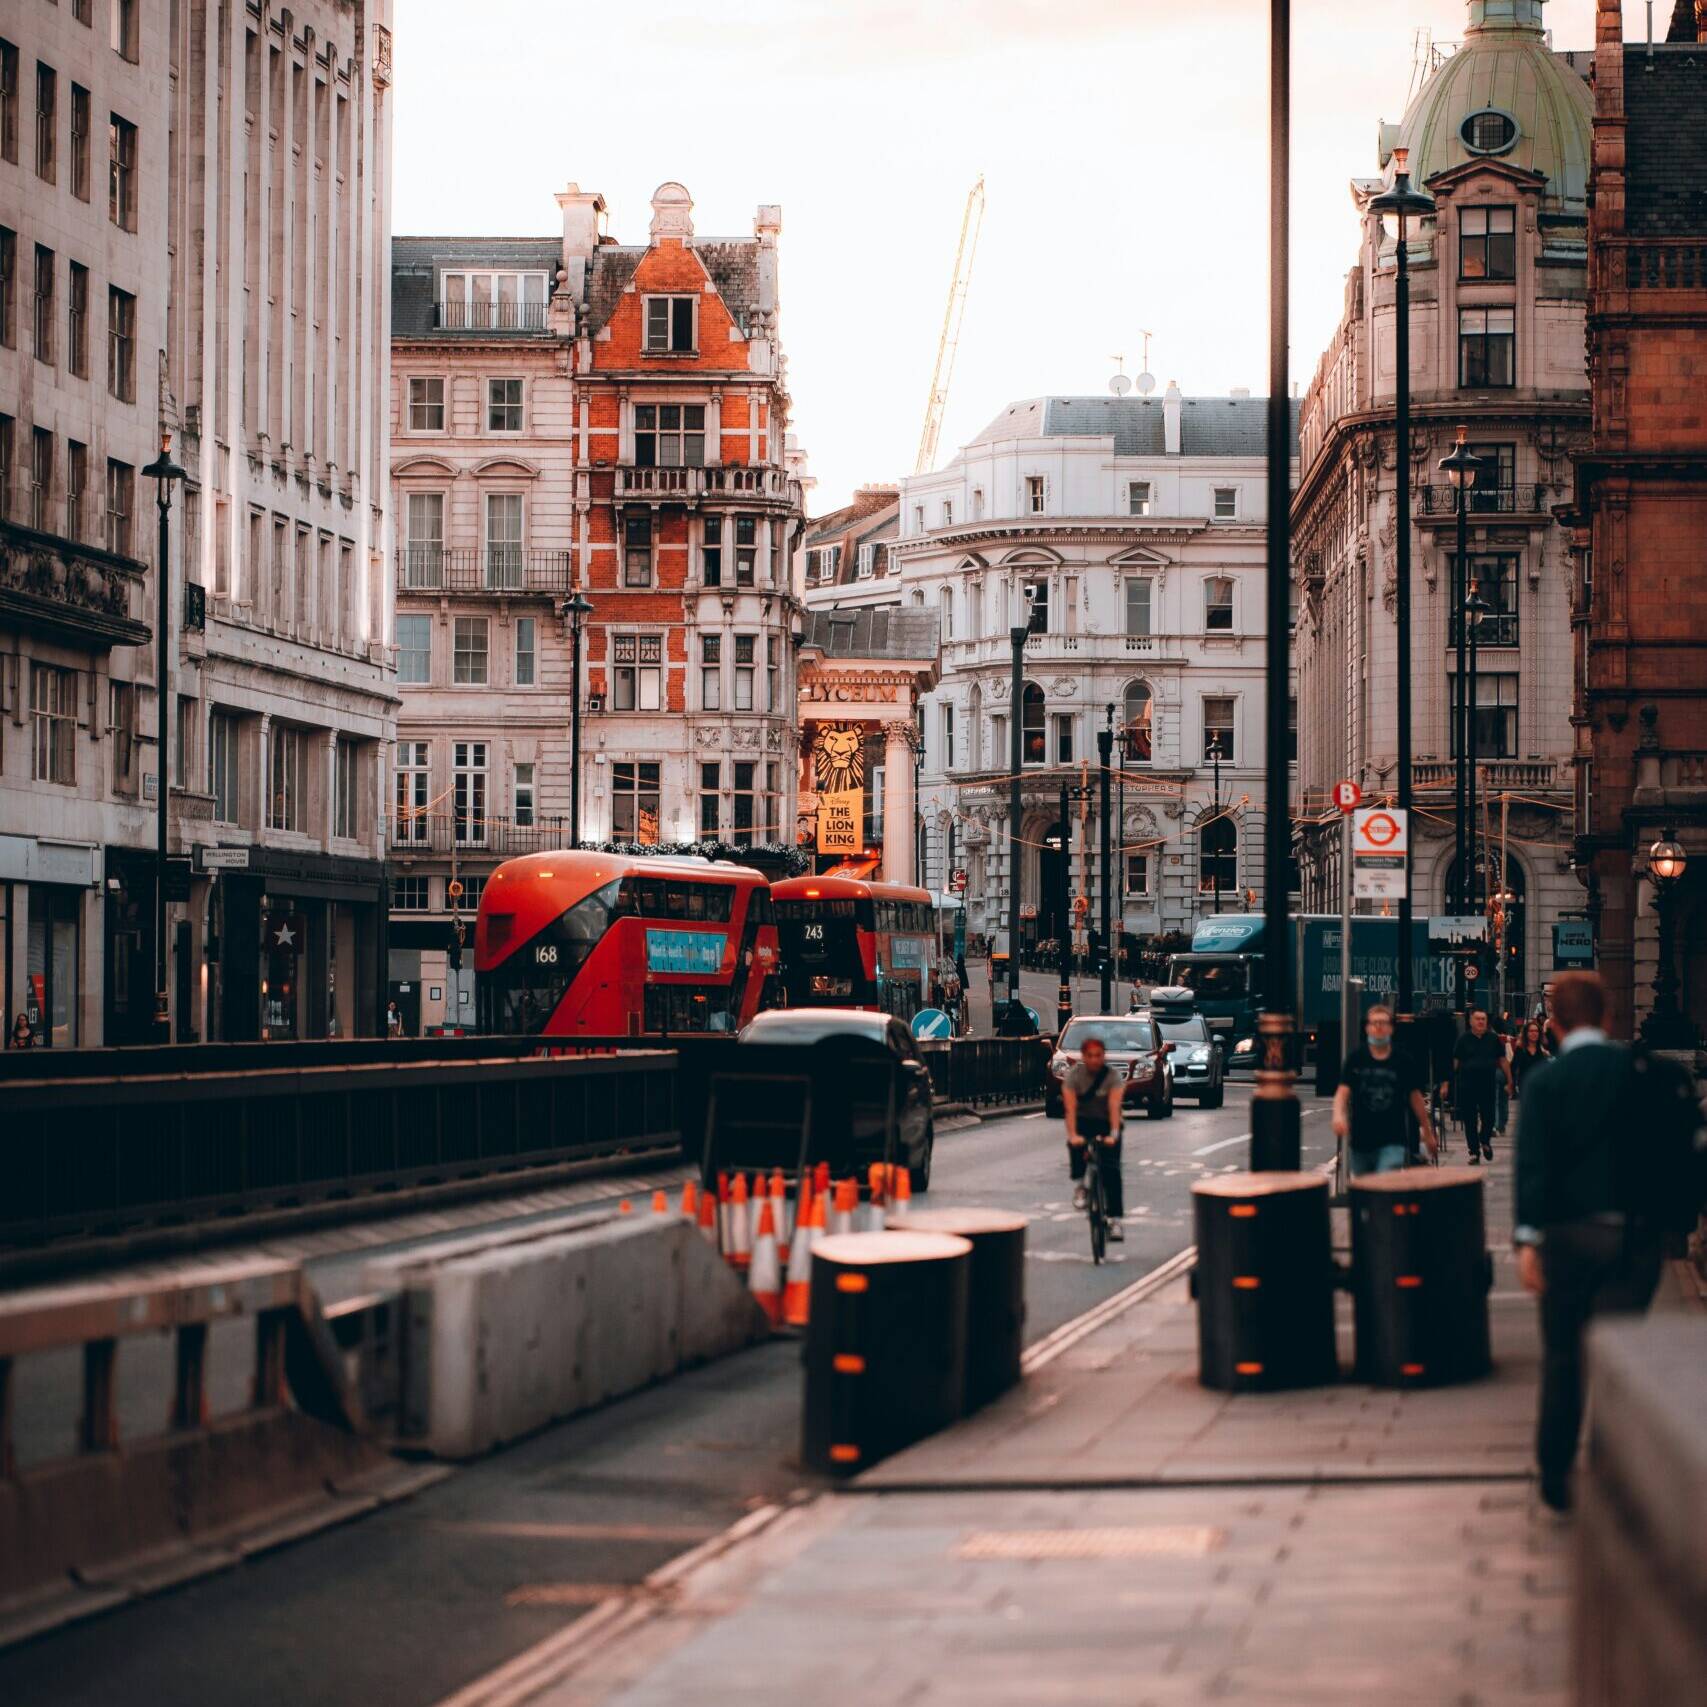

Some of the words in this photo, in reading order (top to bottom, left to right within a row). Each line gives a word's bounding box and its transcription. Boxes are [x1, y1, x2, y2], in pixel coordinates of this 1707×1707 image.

[810, 685, 897, 702] LYCEUM
[1340, 783, 1356, 805] B
[829, 807, 850, 817] THE
[826, 820, 854, 830] LION
[825, 834, 855, 844] KING
[804, 925, 823, 940] 243
[535, 945, 558, 963] 168
[1394, 957, 1438, 992] SNCE
[1439, 957, 1456, 992] 18
[1465, 968, 1477, 976] 20
[1368, 974, 1392, 992] CLOCK
